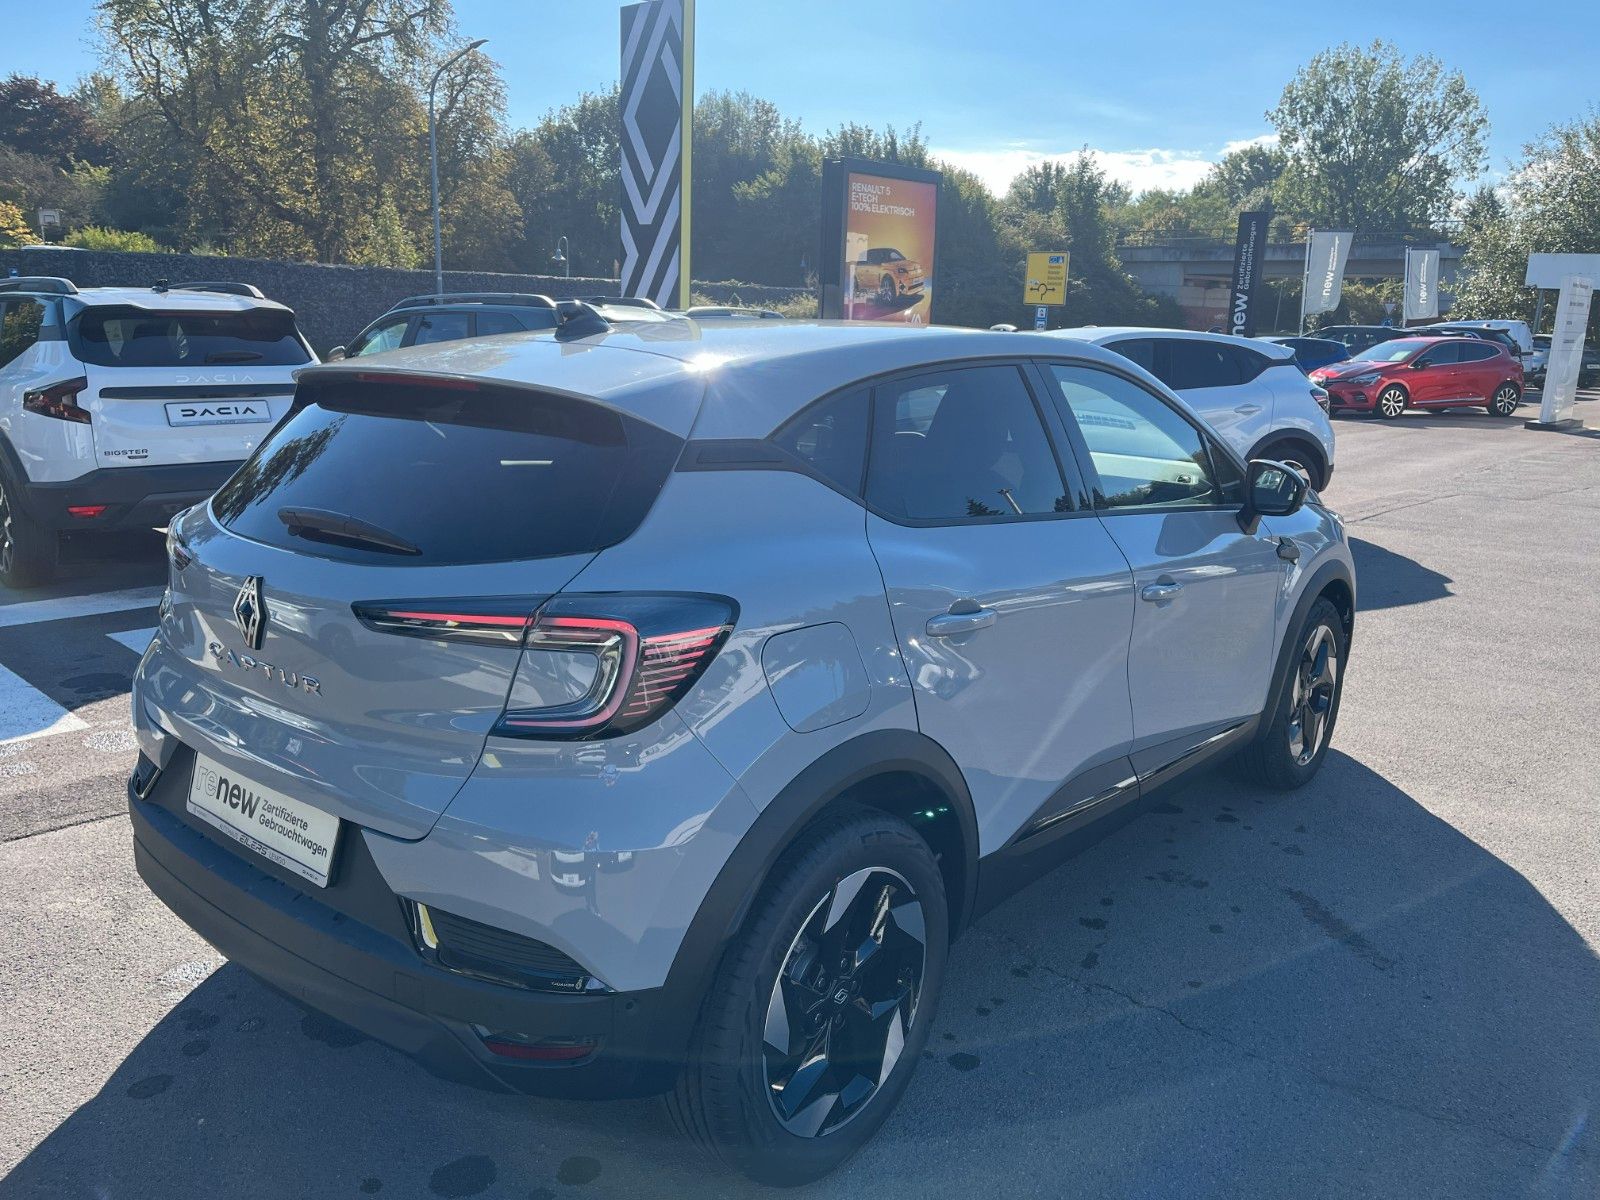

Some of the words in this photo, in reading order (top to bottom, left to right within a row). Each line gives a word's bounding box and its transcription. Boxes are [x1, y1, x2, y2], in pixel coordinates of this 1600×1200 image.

[852, 182, 885, 195] RENAULT
[886, 186, 891, 196] 5
[851, 202, 871, 213] 100%
[872, 203, 915, 216] ELEKTRISCH
[1243, 221, 1256, 290] Gebrauchtwagen
[175, 374, 254, 383] DACIA
[181, 406, 257, 417] DACIA
[104, 448, 149, 457] BIGSTER
[209, 641, 323, 697] CAPTUR
[195, 766, 261, 819] renew
[261, 799, 309, 832] Zertifizierte
[239, 834, 268, 856] EILERS
[259, 813, 328, 858] Gebrauchtwagen
